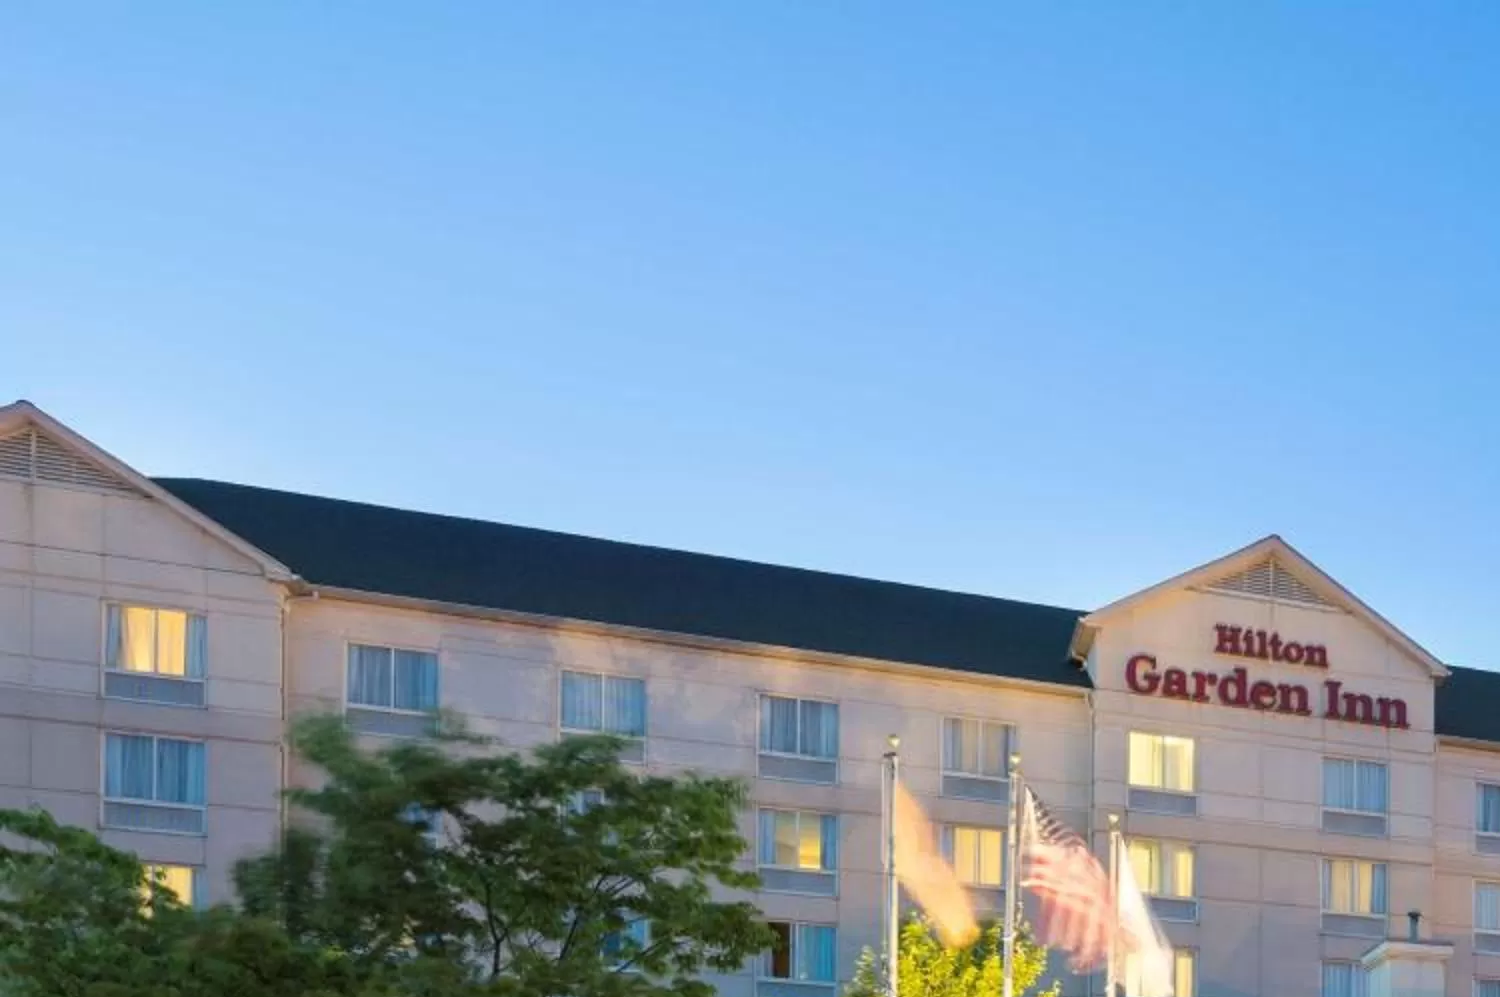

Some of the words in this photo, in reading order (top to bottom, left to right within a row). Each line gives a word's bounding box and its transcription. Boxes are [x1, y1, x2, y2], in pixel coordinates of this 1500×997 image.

[1213, 622, 1329, 668] Hilton
[1125, 652, 1312, 717] Garden
[1323, 679, 1411, 730] Inn
